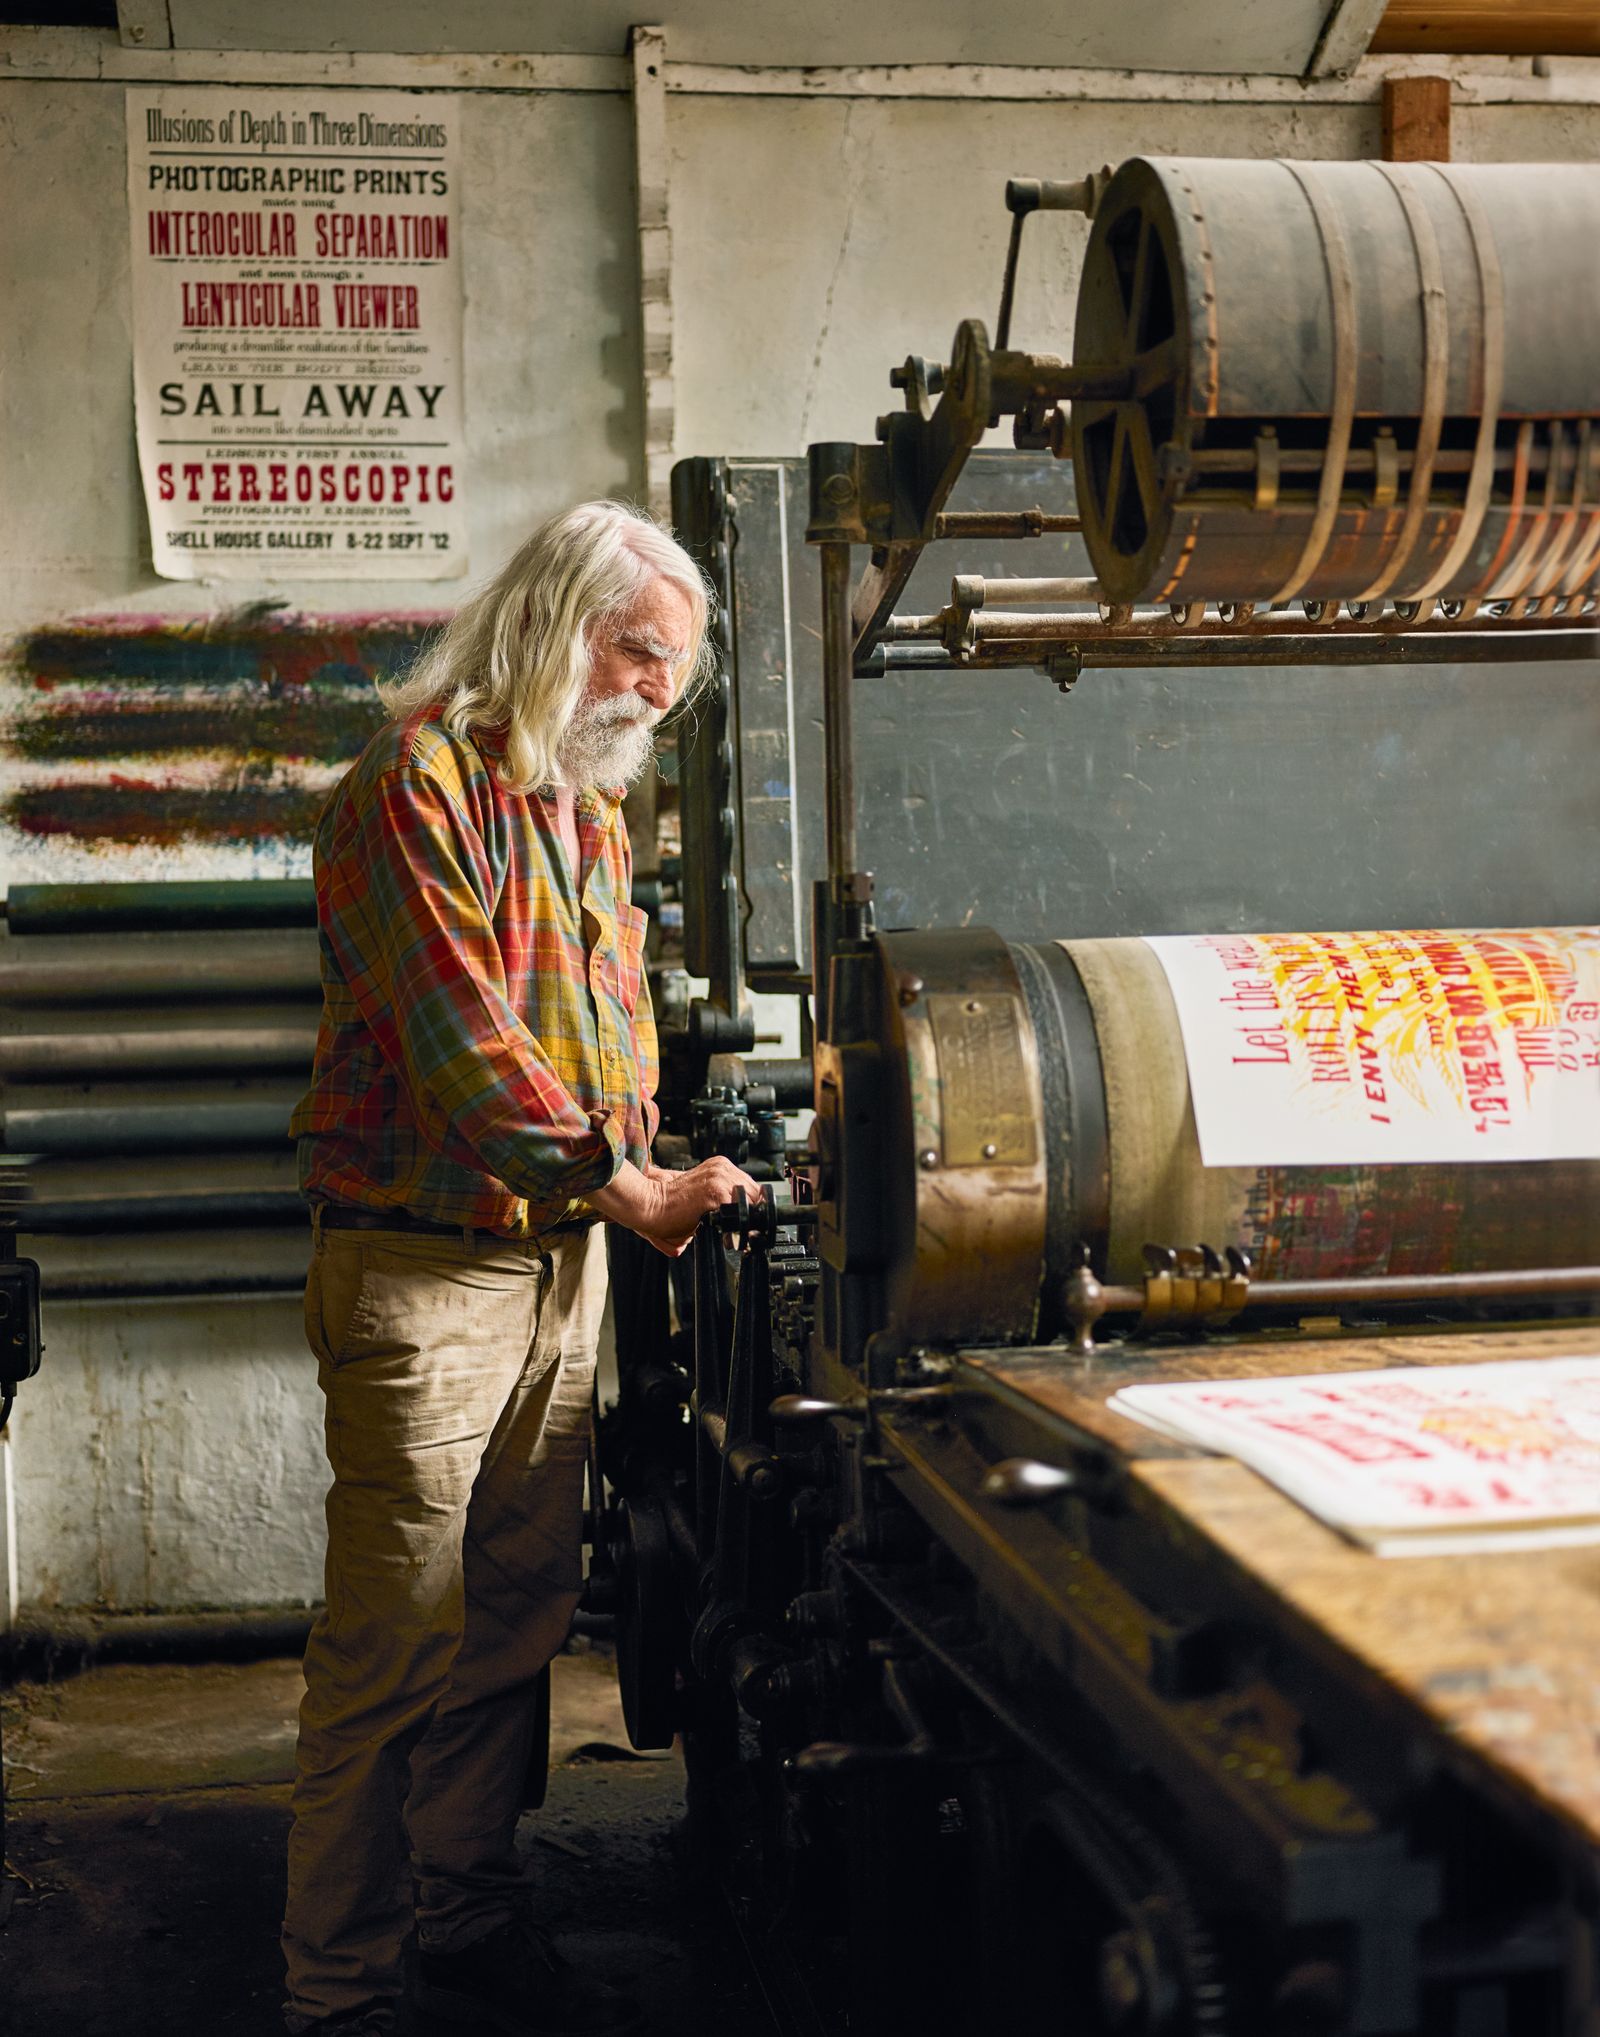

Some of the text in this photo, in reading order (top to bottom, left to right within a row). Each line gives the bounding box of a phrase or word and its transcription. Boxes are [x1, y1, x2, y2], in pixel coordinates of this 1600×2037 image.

[146, 108, 447, 152] Illusions of Depth in Three Dimensions
[148, 165, 448, 196] PHOTOGRAPHIC PRINTS
[262, 199, 336, 209] made using
[148, 211, 448, 259] INTEROCULAR SEPARATION
[239, 269, 262, 278] and
[181, 282, 420, 329] LENTICULAR VIEWER
[182, 363, 239, 373] LEAVE
[250, 363, 284, 373] THE
[159, 383, 446, 417] SAIL AWAY
[158, 463, 454, 504] STEREOSCOPIC
[167, 532, 209, 549] SHELL
[214, 532, 263, 549] HOUSE
[267, 532, 333, 549] GALLERY
[347, 533, 383, 549] 8-22
[388, 533, 424, 549] SEPT
[1370, 965, 1394, 988] eat
[1421, 941, 1472, 977] OWN
[1219, 980, 1280, 1010] the
[1296, 990, 1336, 1010] IN
[1328, 954, 1368, 1014] THEM
[1408, 966, 1433, 1004] own
[1441, 981, 1487, 1017] MY
[1232, 1024, 1291, 1063] Let
[1424, 1012, 1445, 1045] my
[1303, 1020, 1351, 1083] ROLL
[1353, 1024, 1387, 1103] ENVY
[1370, 1113, 1391, 1125] I
